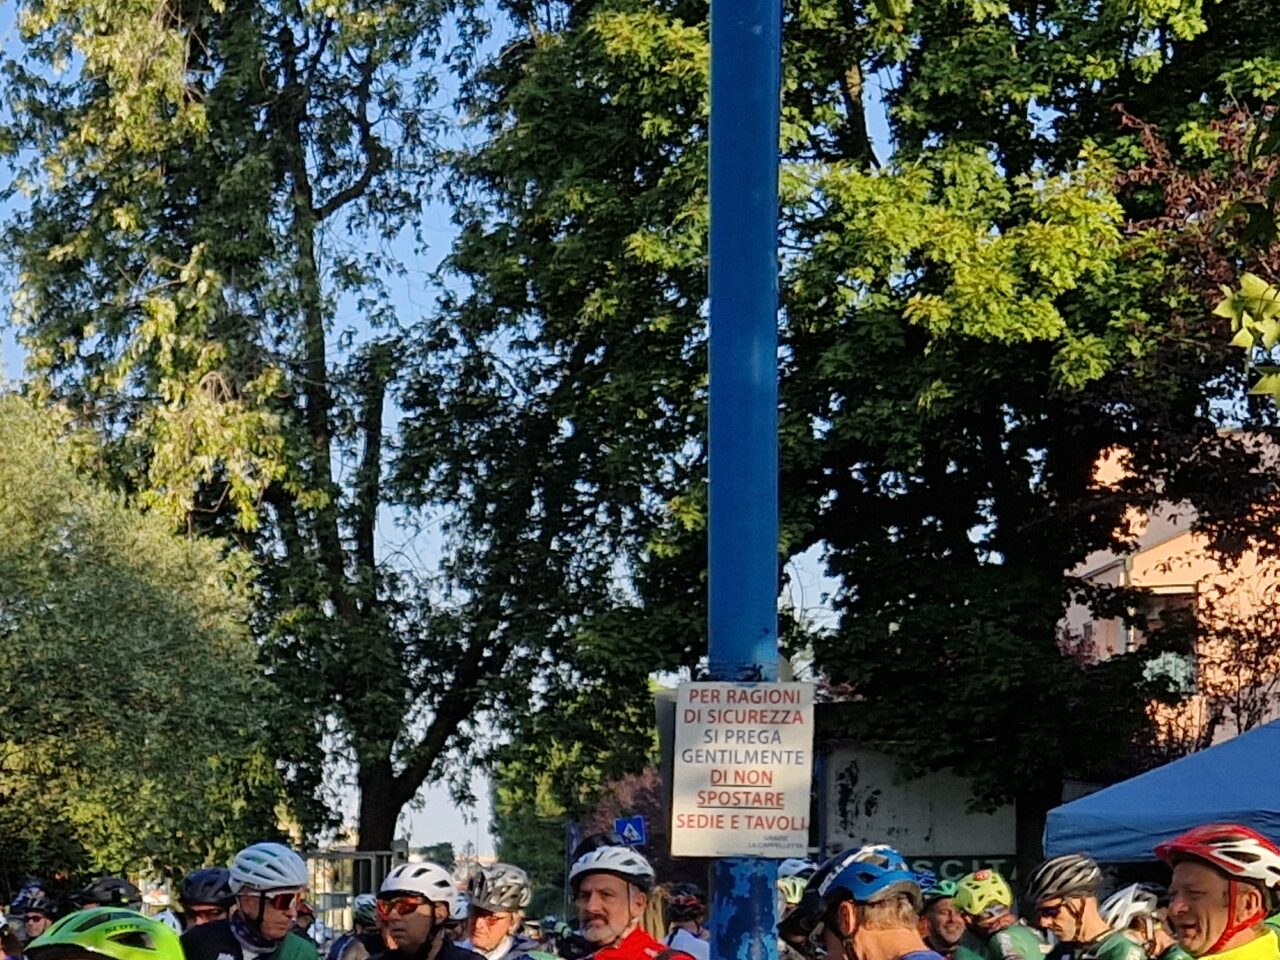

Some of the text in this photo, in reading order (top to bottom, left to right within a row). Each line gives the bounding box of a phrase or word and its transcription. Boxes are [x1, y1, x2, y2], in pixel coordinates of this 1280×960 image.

[689, 689, 801, 705] PER RAGIONI
[683, 709, 803, 724] DI SICUREZZA
[703, 729, 782, 744] SI PREGA
[681, 749, 804, 765] GENTILMENTE
[710, 769, 773, 785] DI NON
[697, 790, 784, 807] SPOSTARE
[676, 814, 805, 831] SEDIE E TAVOLI
